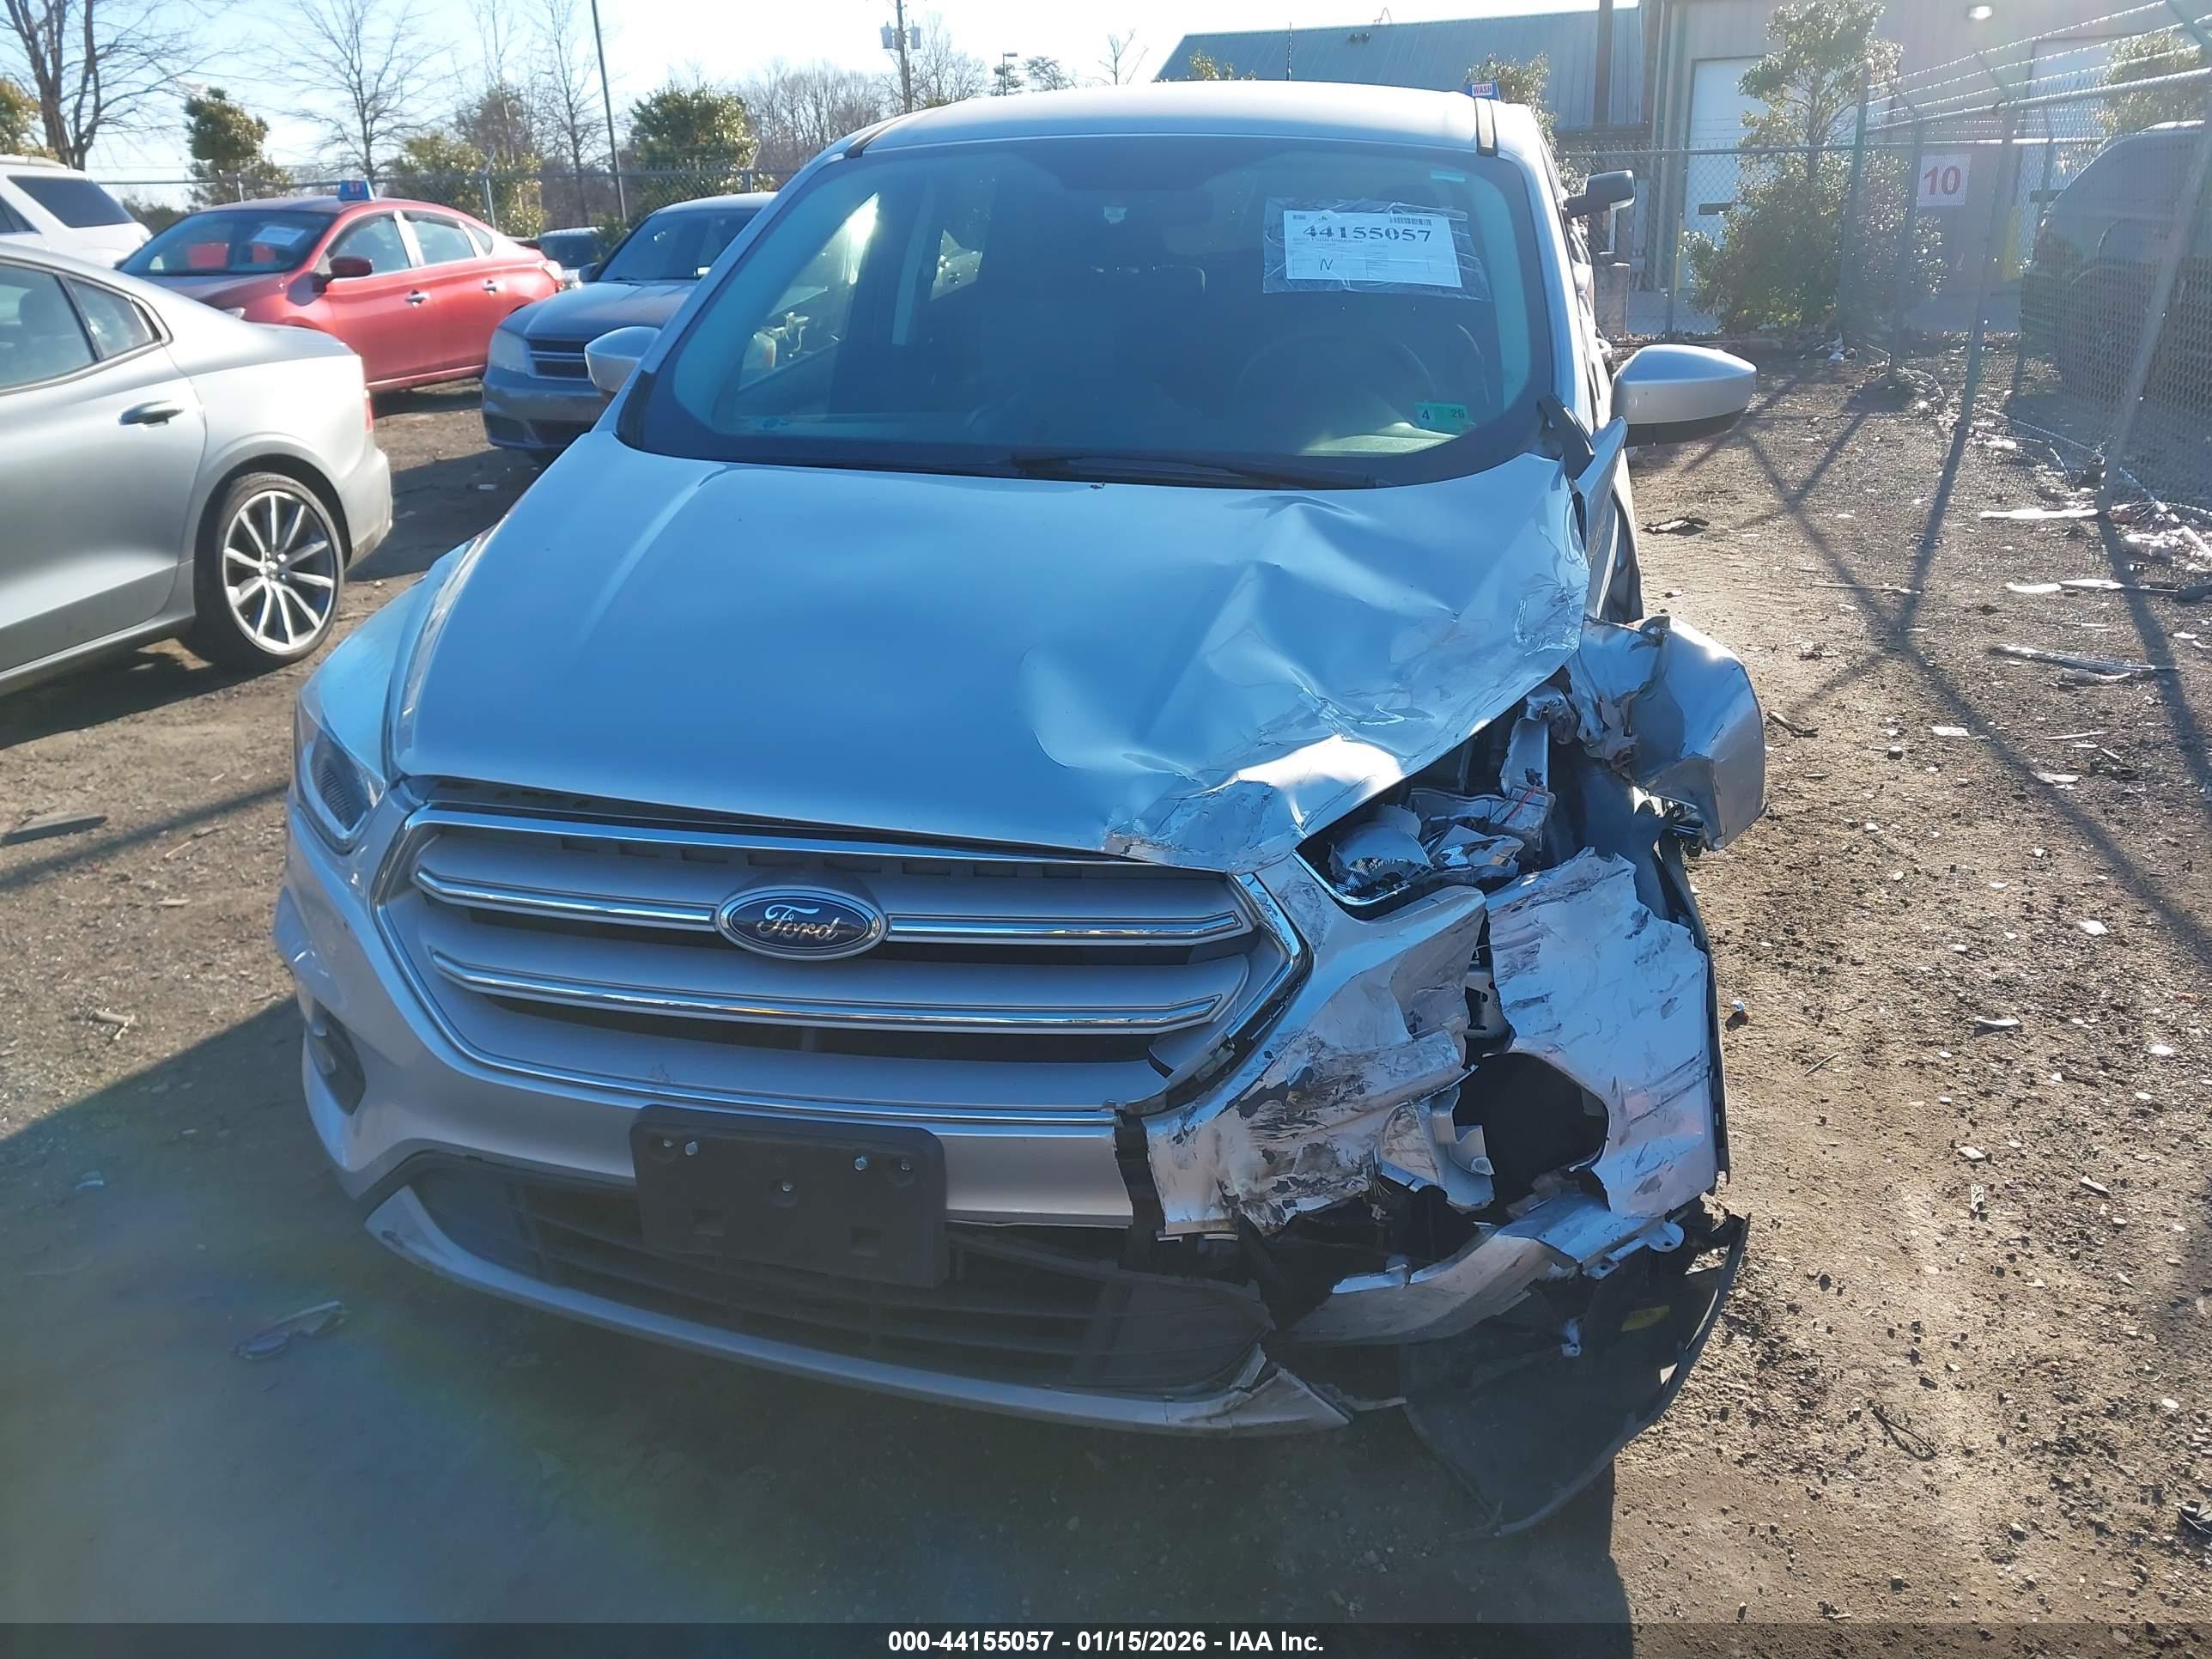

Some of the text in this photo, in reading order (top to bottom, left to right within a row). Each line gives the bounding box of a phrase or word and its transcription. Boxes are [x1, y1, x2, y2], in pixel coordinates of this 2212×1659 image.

[1474, 85, 1492, 94] WASH
[1923, 166, 1961, 195] 10
[1303, 225, 1432, 243] 44155057
[1320, 258, 1333, 271] N
[1422, 410, 1430, 420] 4
[756, 904, 841, 941] Ford
